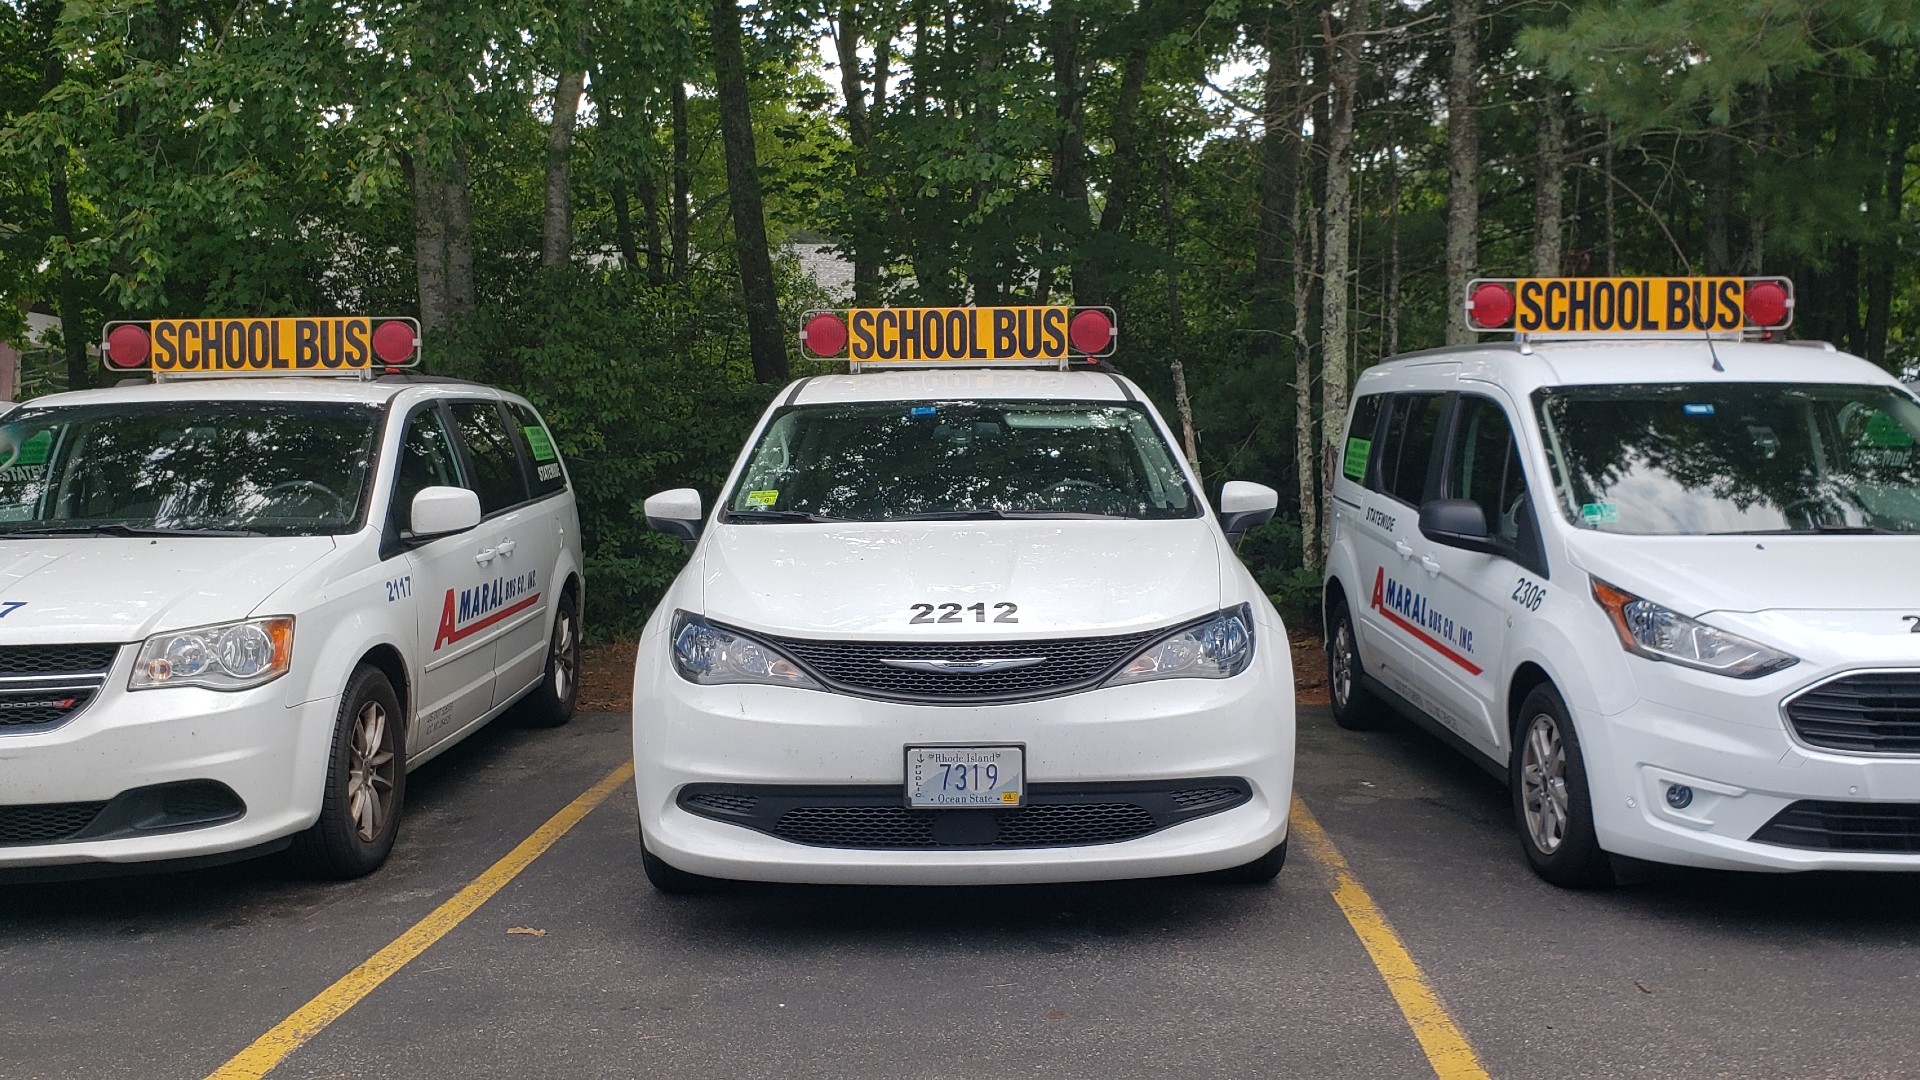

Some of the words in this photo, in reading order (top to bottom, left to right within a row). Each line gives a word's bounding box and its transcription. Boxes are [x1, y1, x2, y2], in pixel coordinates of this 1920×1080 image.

[1520, 281, 1659, 331] SCHOOL
[1667, 280, 1742, 331] BUS
[154, 321, 290, 369] SCHOOL
[296, 320, 368, 368] BUS
[852, 310, 987, 359] SCHOOL
[993, 308, 1066, 358] BUS
[1365, 506, 1396, 532] STATEWIDE
[386, 576, 412, 602] 2117
[1511, 577, 1547, 612] 2306
[433, 577, 503, 651] AMARAL
[505, 577, 517, 600] BUS
[908, 602, 1019, 625] 2212
[1370, 566, 1426, 627] AMARAL
[1428, 609, 1443, 634] BUS
[1459, 626, 1474, 654] INC.
[935, 753, 964, 763] Rhode
[966, 752, 995, 763] Island
[940, 763, 998, 790] 7319
[938, 794, 967, 803] Ocean
[969, 794, 993, 803] State
